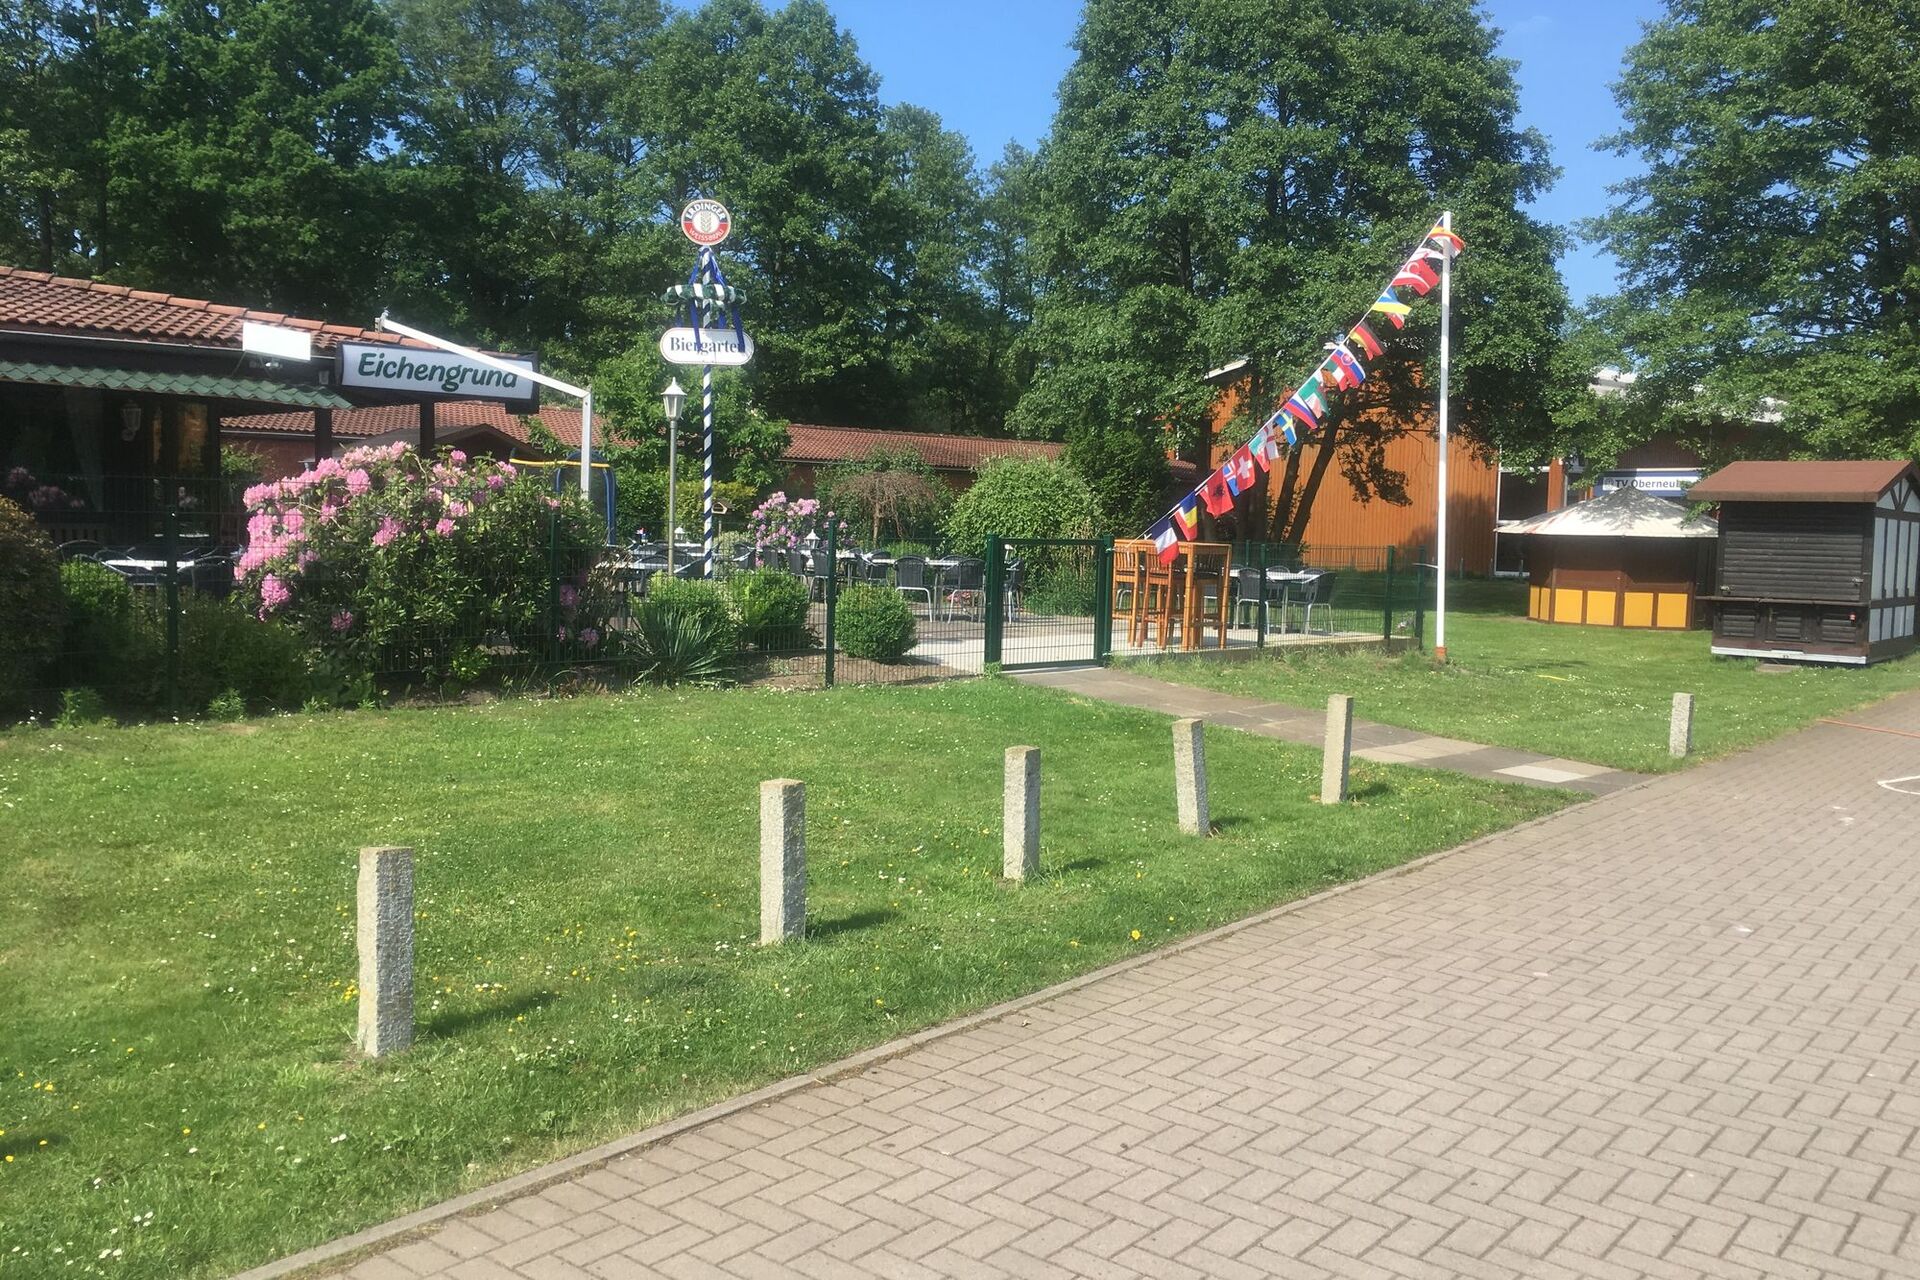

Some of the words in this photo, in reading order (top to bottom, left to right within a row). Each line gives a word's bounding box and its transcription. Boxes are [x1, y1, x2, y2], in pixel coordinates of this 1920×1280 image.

[685, 202, 726, 220] ERDINGER
[670, 336, 744, 355] Biergarte
[358, 352, 519, 393] Eichengrund
[1615, 479, 1629, 488] TV
